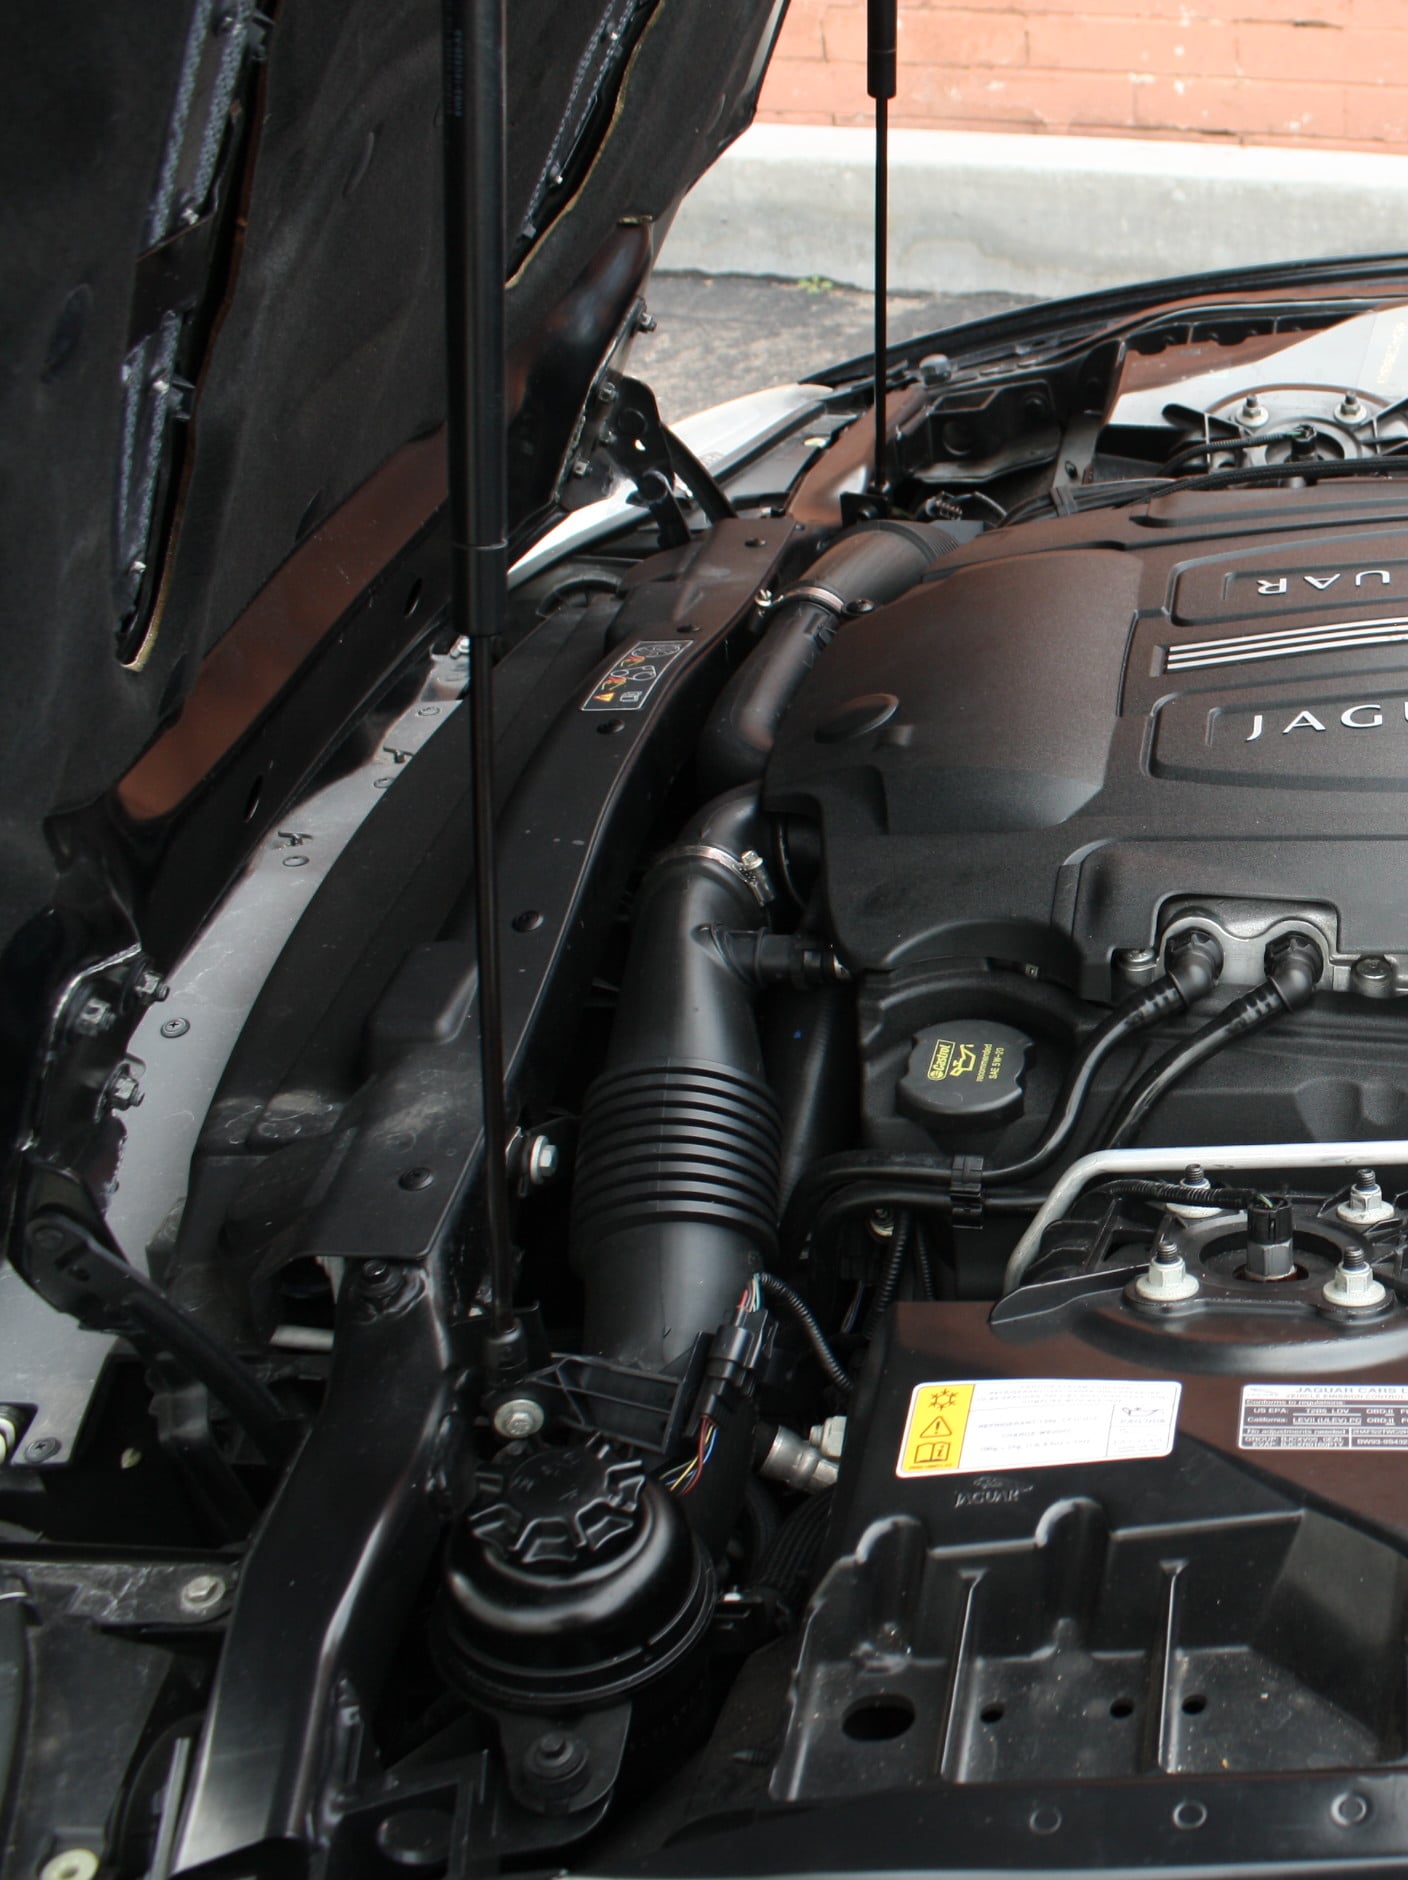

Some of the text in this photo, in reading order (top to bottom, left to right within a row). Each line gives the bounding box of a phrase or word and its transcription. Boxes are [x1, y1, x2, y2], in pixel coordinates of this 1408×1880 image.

[933, 1044, 951, 1071] Castrol
[976, 1043, 992, 1082] recommended
[988, 1068, 1000, 1079] SAE
[954, 1488, 1020, 1508] JAGUAR
